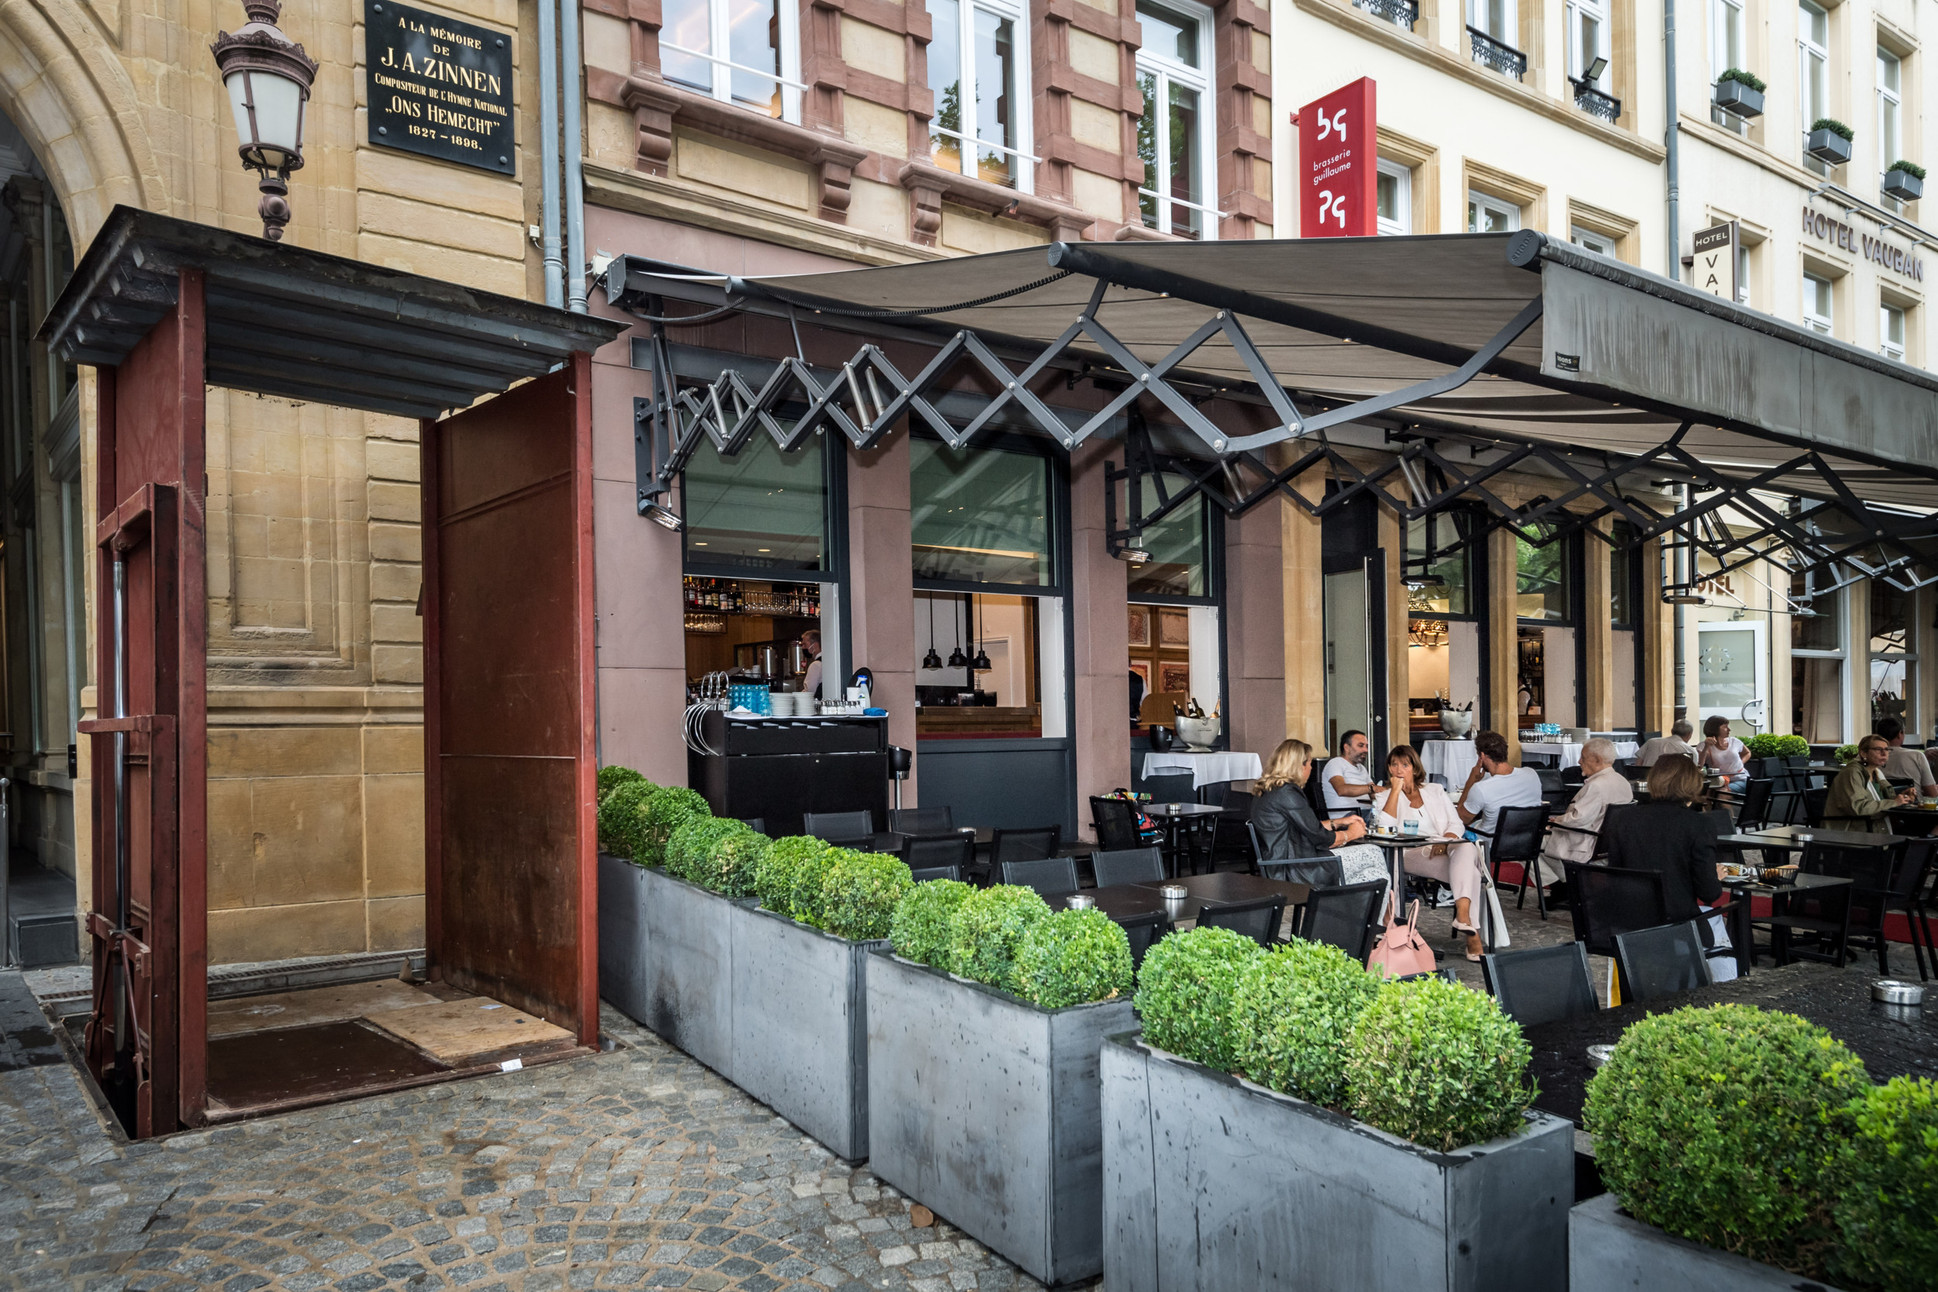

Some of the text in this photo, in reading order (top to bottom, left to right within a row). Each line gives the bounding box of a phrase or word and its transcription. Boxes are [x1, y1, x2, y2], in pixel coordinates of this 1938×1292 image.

[399, 17, 482, 50] A LA MÉMOIRE
[433, 44, 450, 56] DE
[429, 87, 439, 99] DE
[1313, 148, 1351, 172] brasserie
[1313, 161, 1351, 186] guillaume
[1695, 231, 1728, 247] HOTEL
[1802, 206, 1924, 282] HOTEL VAUBAN
[1705, 253, 1719, 295] VA
